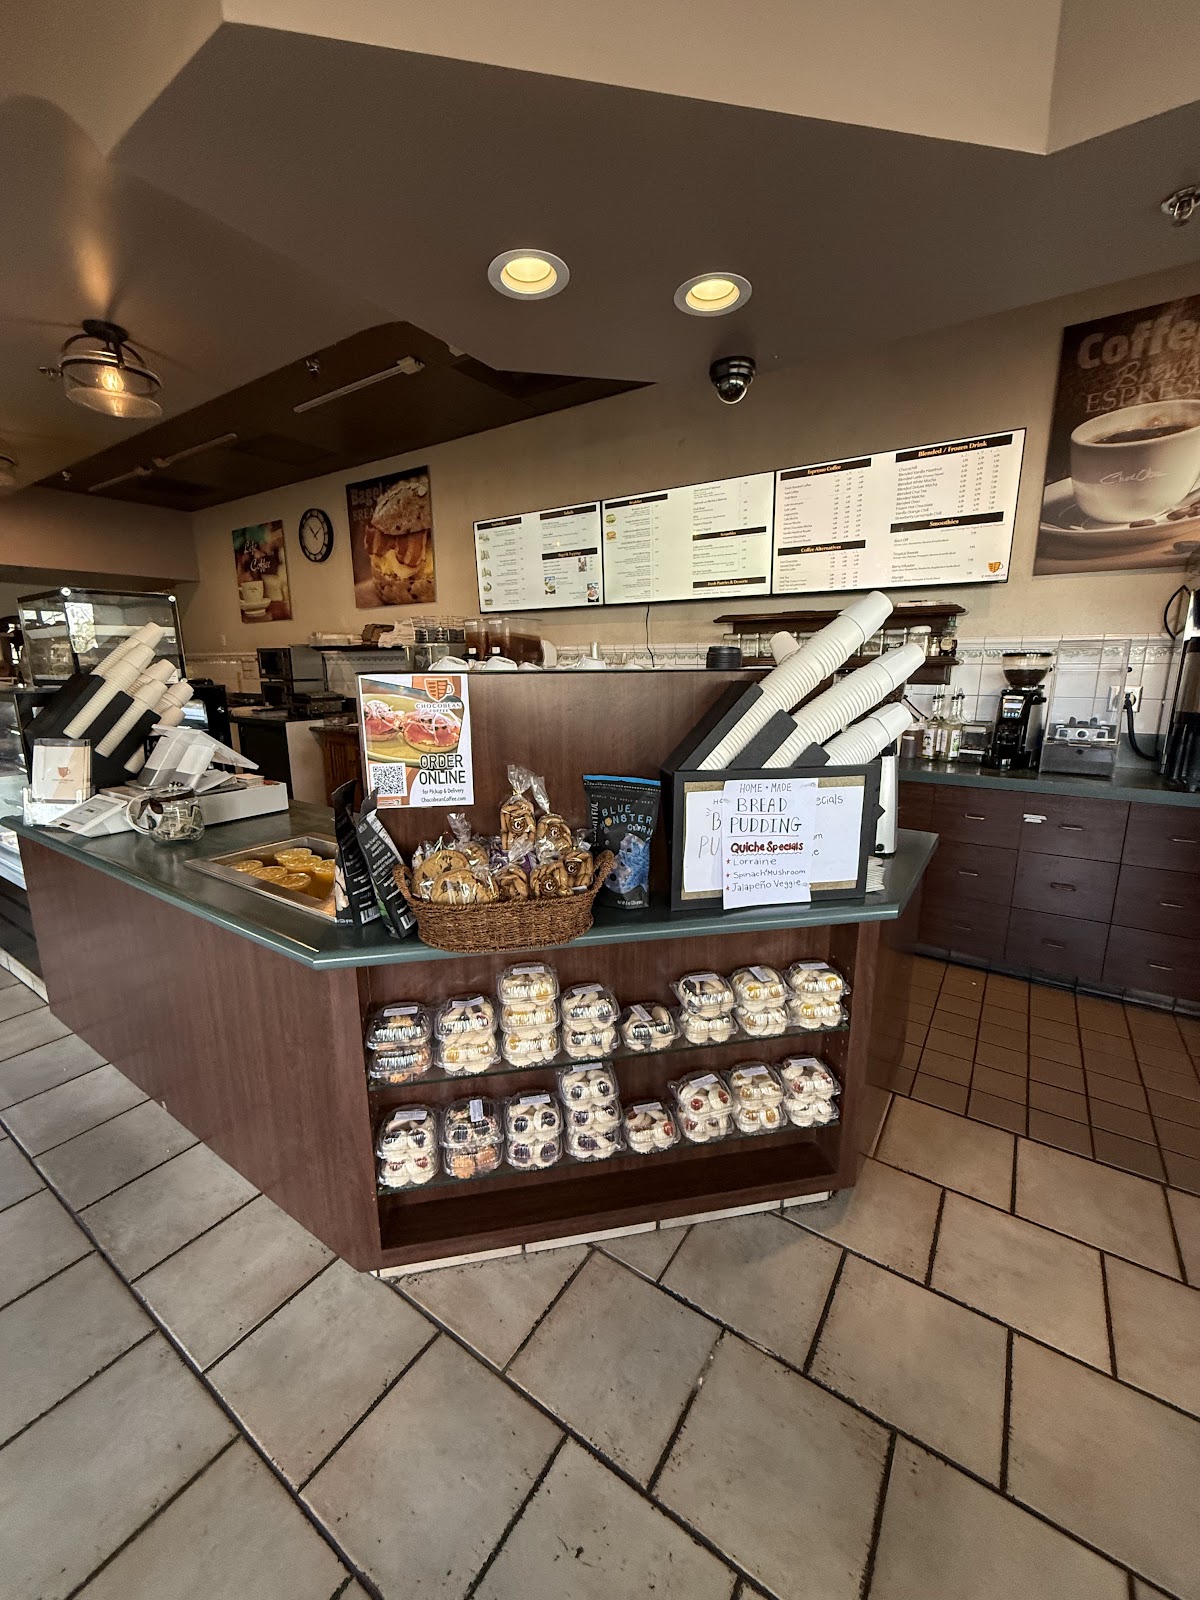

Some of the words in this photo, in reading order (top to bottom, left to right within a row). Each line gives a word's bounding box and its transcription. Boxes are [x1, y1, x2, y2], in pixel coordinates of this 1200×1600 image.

[1077, 314, 1200, 369] Coffe
[918, 448, 942, 458] Blended
[948, 443, 969, 453] Frozen
[969, 440, 988, 449] Drink
[250, 558, 271, 573] Coffee
[420, 754, 463, 769] ORDER
[420, 770, 466, 785] ONLINE
[740, 782, 762, 793] HOME
[770, 782, 792, 792] MADE
[602, 804, 631, 817] BLUE
[738, 798, 787, 812] BREAD
[600, 814, 653, 830] MONSTER
[730, 816, 802, 833] PUDDING
[731, 841, 765, 854] Quiche
[766, 841, 804, 853] Specials
[734, 858, 777, 866] Lorraine
[732, 881, 772, 892] Jalapeño
[774, 880, 801, 889] Veggie
